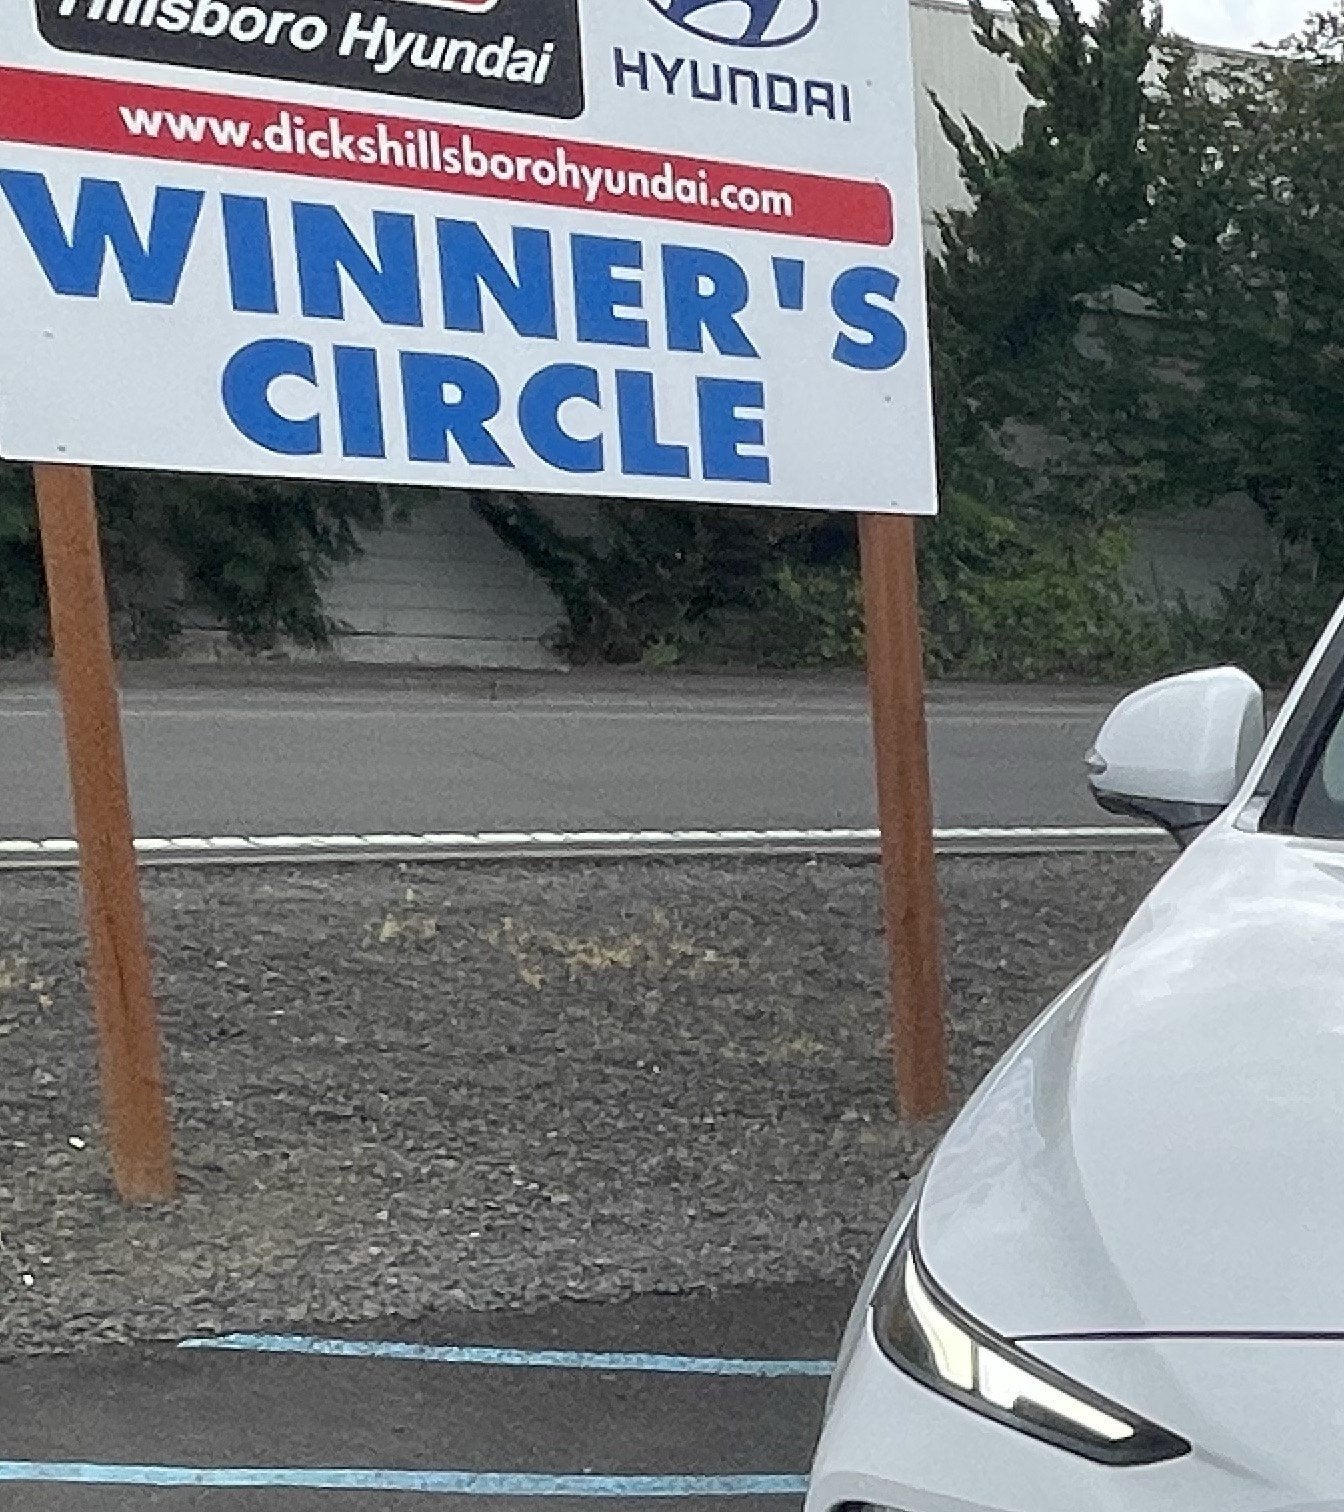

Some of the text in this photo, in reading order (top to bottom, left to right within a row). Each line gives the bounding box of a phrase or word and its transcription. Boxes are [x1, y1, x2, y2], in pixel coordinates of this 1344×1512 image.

[338, 12, 555, 85] Hyundai
[613, 46, 852, 123] HYUNDAI
[119, 104, 794, 219] www.dickshillsborohyundai.com
[0, 168, 908, 371] WINNER'S
[221, 337, 771, 485] CIRCLE
